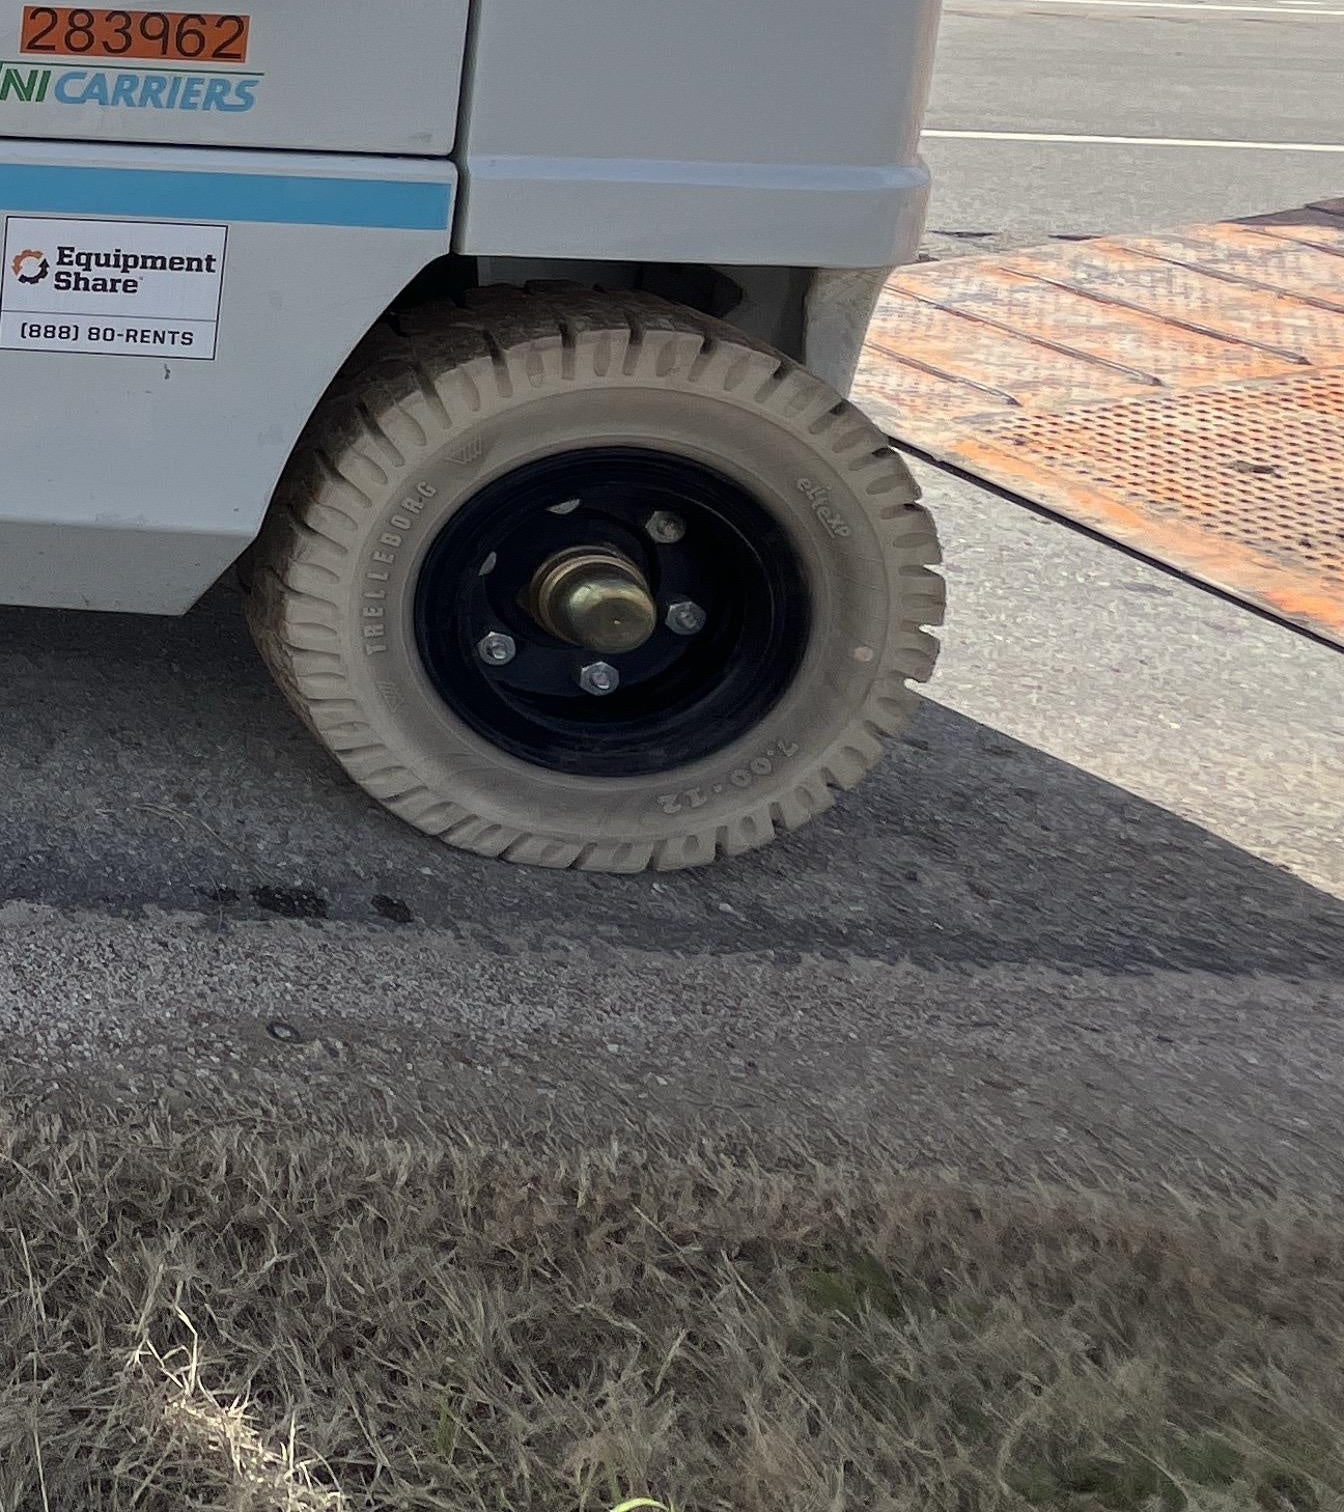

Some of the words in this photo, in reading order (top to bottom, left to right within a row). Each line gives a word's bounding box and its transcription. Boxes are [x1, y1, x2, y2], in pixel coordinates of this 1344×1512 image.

[25, 6, 246, 59] 283962
[56, 246, 217, 273] Equipment
[54, 271, 139, 294] Share
[20, 322, 80, 341] (888)
[87, 326, 194, 346] 80-RENTS
[362, 481, 437, 656] TRELLEBORG
